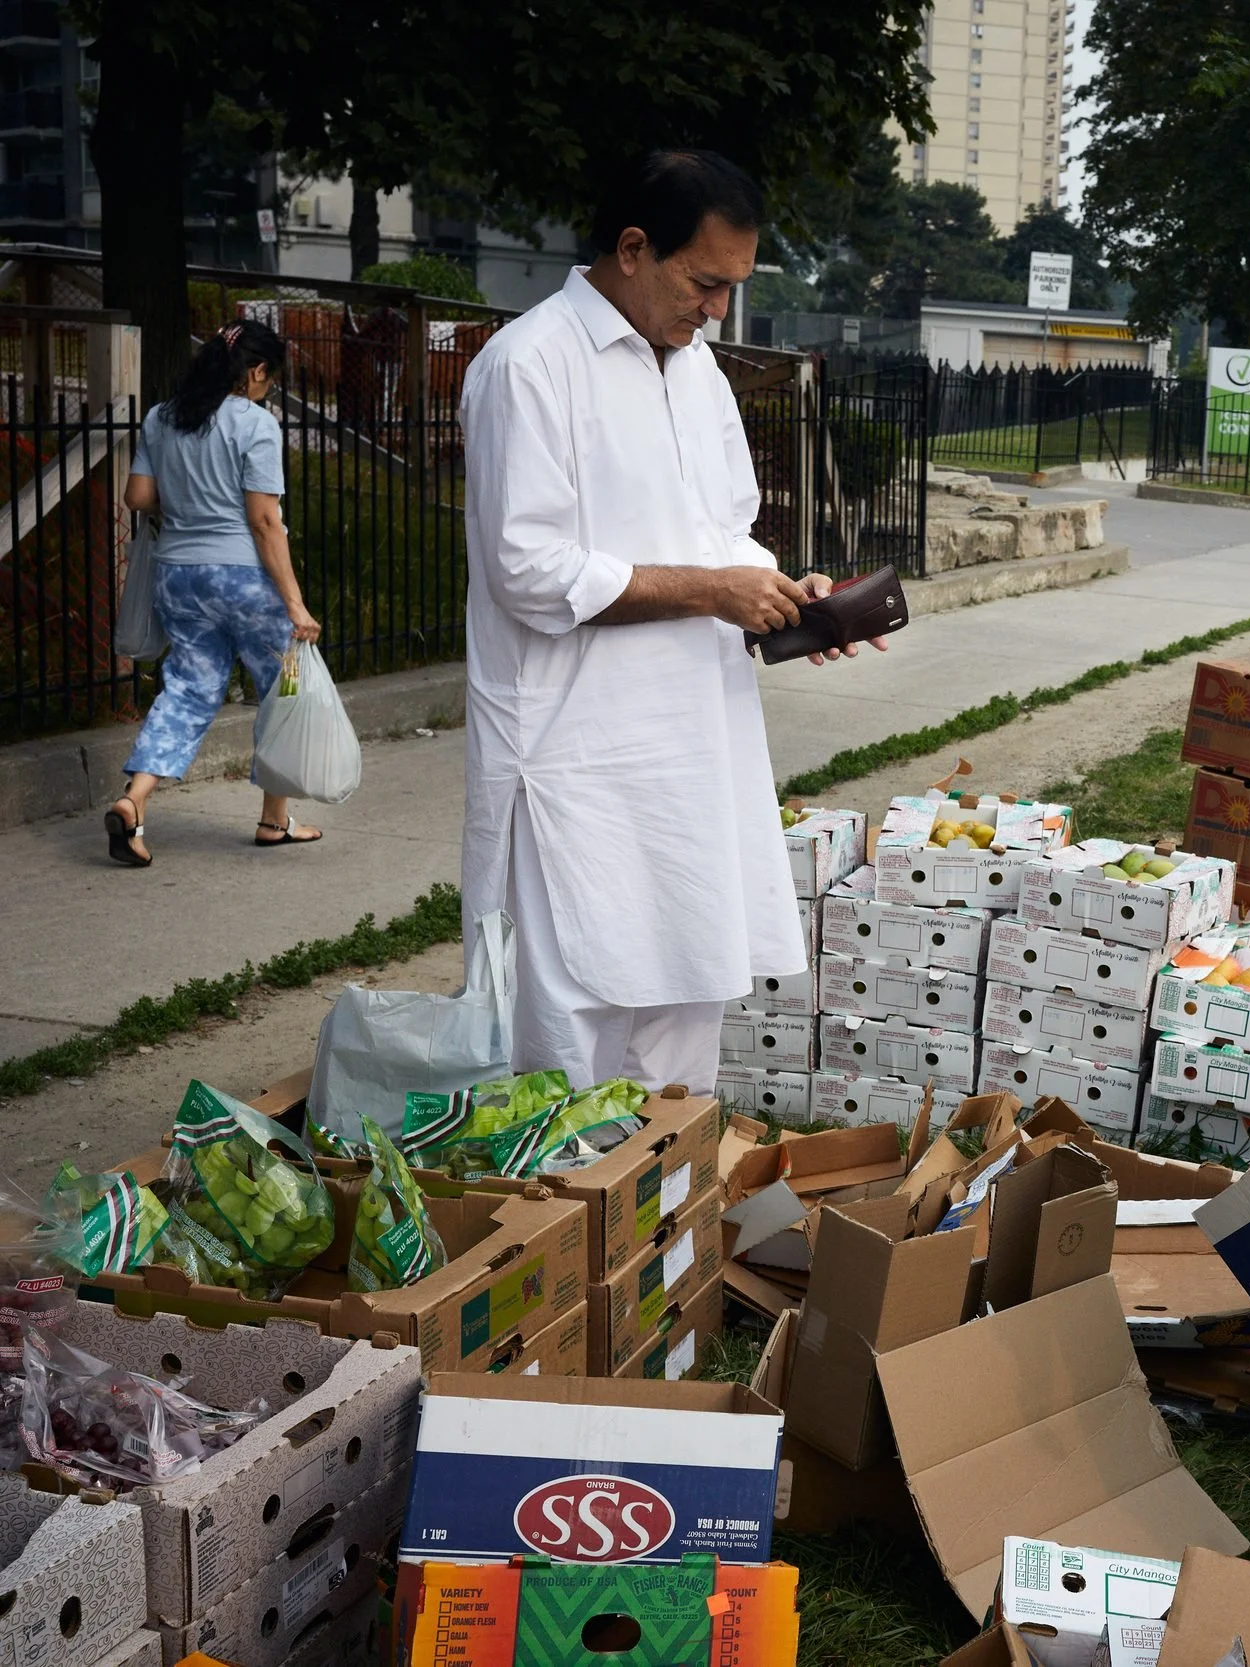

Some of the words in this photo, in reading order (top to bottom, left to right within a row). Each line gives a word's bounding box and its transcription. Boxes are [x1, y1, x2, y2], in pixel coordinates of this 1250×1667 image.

[1032, 265, 1070, 275] AUTHORIZED
[1034, 275, 1067, 284] PARKING
[1040, 284, 1060, 293] ONLY
[1210, 995, 1223, 1005] City
[1224, 998, 1249, 1010] Mangos
[1210, 1058, 1223, 1068] City
[1224, 1060, 1249, 1071] Mangos
[20, 1281, 39, 1291] PLU
[585, 1480, 616, 1490] BRAND
[540, 1490, 654, 1558] SSS
[697, 1518, 713, 1529] USA
[714, 1518, 725, 1530] OF
[725, 1519, 760, 1532] PRODUCE
[429, 1528, 448, 1541] CAT.
[687, 1530, 707, 1538] 83607
[708, 1531, 727, 1539] Idaho
[728, 1532, 759, 1540] Caldwell,
[680, 1539, 692, 1547] Inc.
[693, 1540, 716, 1548] Ranch,
[717, 1541, 733, 1549] Fruit
[734, 1541, 758, 1550] Symms
[1022, 1542, 1045, 1551] Count
[1108, 1563, 1130, 1576] City
[1132, 1567, 1178, 1582] Mangos
[526, 1576, 576, 1588] PRODUCE
[580, 1576, 594, 1587] OF
[597, 1576, 618, 1587] USA
[632, 1574, 667, 1597] FISHER
[676, 1574, 709, 1596] RANCH
[440, 1588, 483, 1598] VARIETY
[453, 1602, 474, 1612] HONEY
[475, 1602, 490, 1612] DEW
[735, 1603, 742, 1611] 4
[451, 1616, 476, 1626] ORANGE
[477, 1617, 497, 1626] FLESH
[735, 1616, 741, 1625] 5
[450, 1631, 468, 1641] GALIA
[734, 1630, 740, 1638] 6
[449, 1646, 466, 1655] HAMI
[733, 1643, 739, 1651] 8
[733, 1657, 739, 1665] 9
